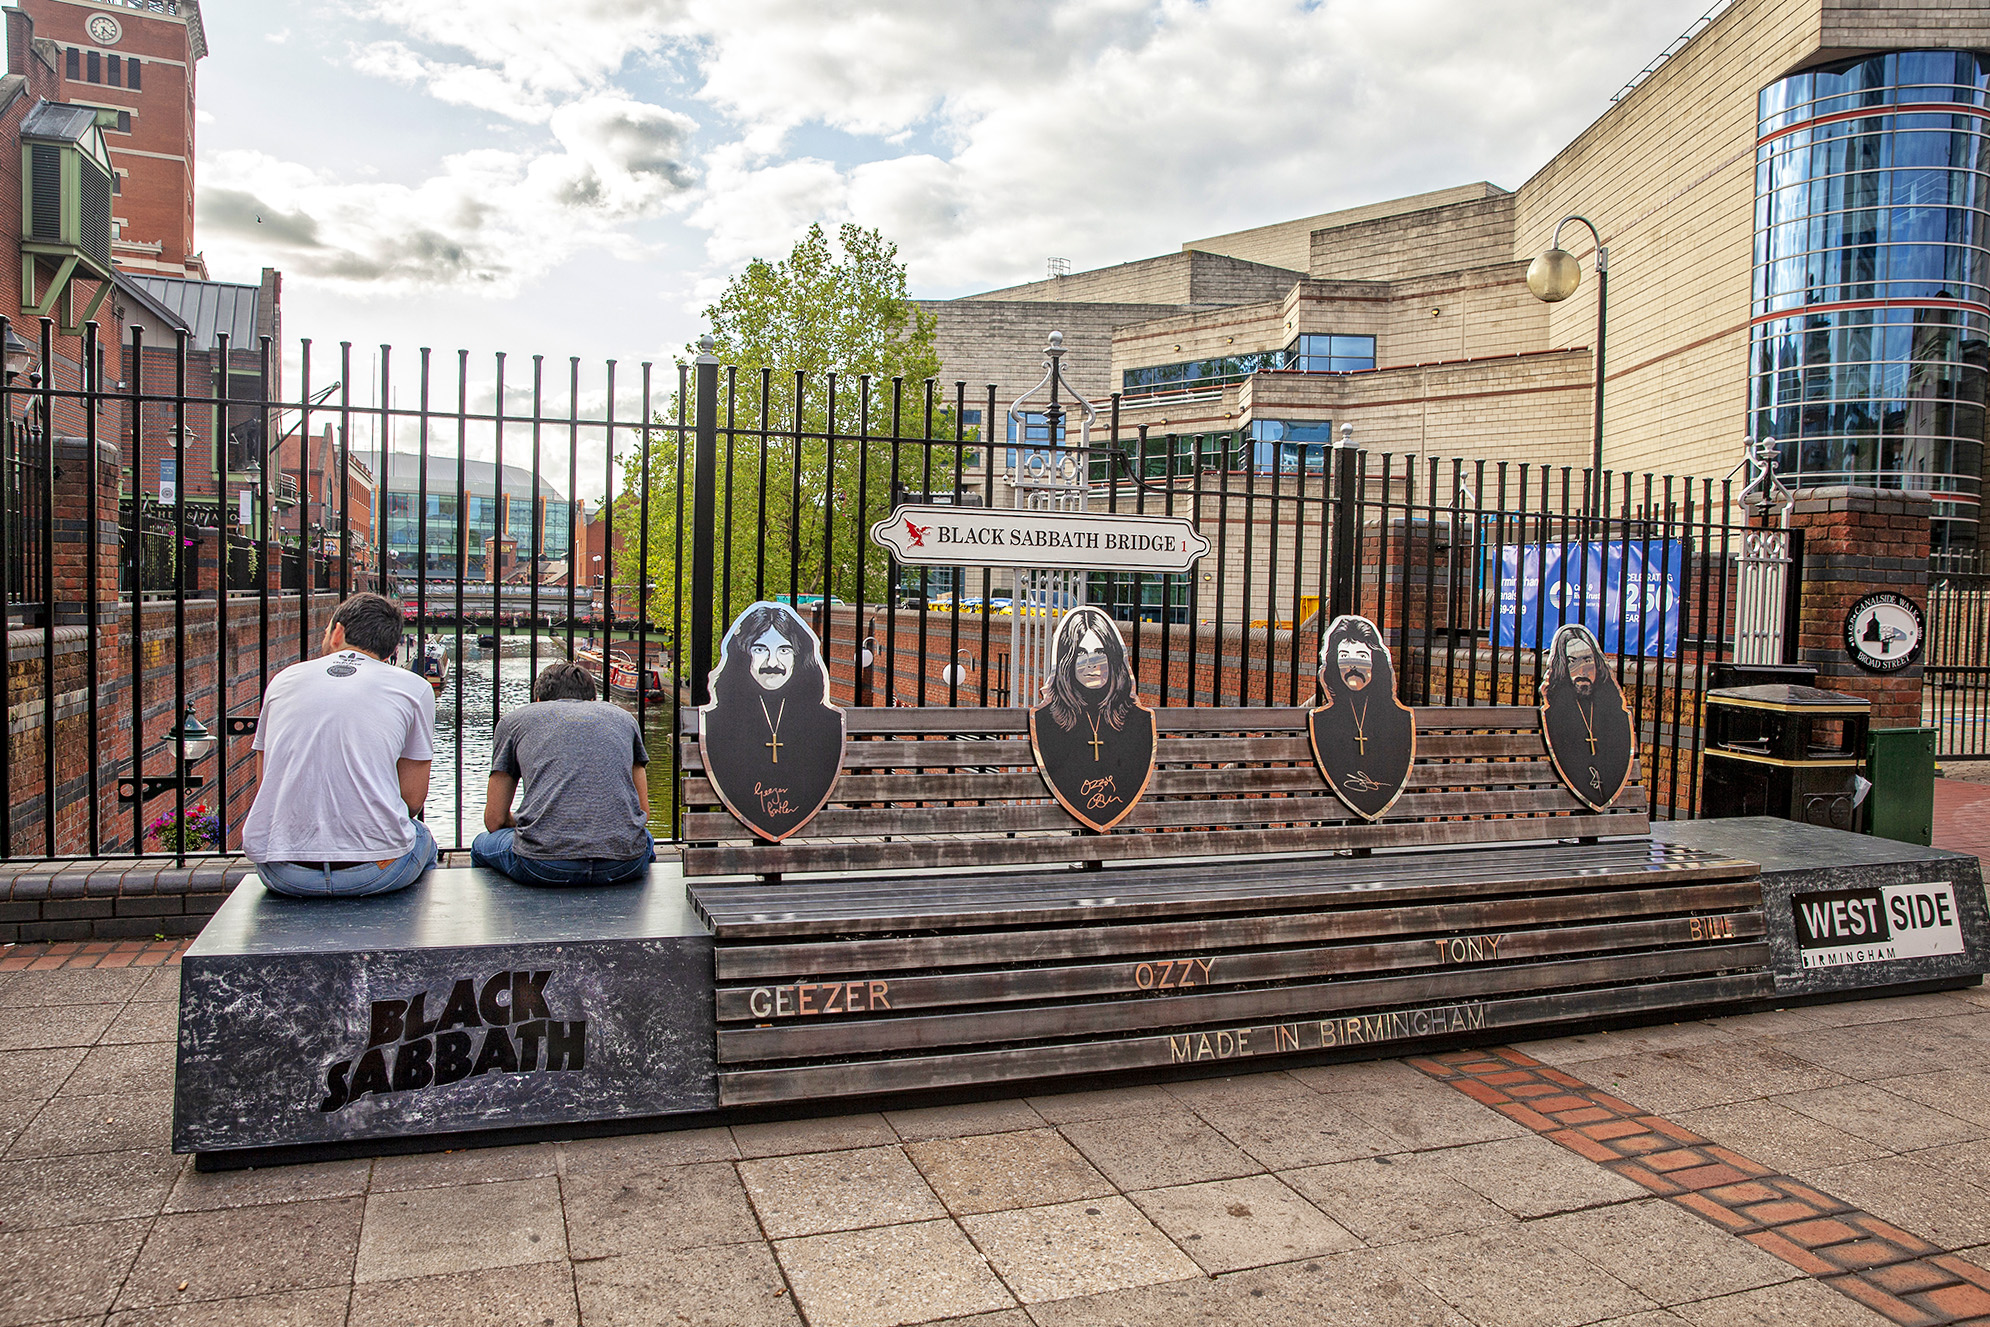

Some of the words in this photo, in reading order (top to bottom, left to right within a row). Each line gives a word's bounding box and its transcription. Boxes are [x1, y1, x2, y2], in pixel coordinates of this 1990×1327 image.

[937, 526, 1005, 545] BLACK
[1010, 528, 1099, 549] SABBATH
[1104, 534, 1176, 551] BRIDGE
[1181, 541, 1187, 553] 1
[1625, 573, 1673, 582] CELERATIG
[1854, 594, 1897, 615] CANALSIDE
[1899, 597, 1919, 618] WALK
[1857, 651, 1881, 669] BROAD
[1882, 653, 1911, 669] STREET
[1689, 916, 1735, 941] BILL
[1801, 898, 1878, 939] WEST
[1890, 893, 1953, 931] SIDE
[1435, 934, 1503, 963] TONY
[1803, 948, 1896, 967] BIRMINGHAM
[1135, 957, 1217, 990] OZZY
[367, 970, 553, 1050] BLACK
[750, 980, 893, 1018] GEEZER
[1169, 1029, 1254, 1064] MADE
[1274, 1023, 1301, 1052] IN
[1319, 1005, 1486, 1048] BIRMINGHAM
[319, 1020, 586, 1112] SABBATH
